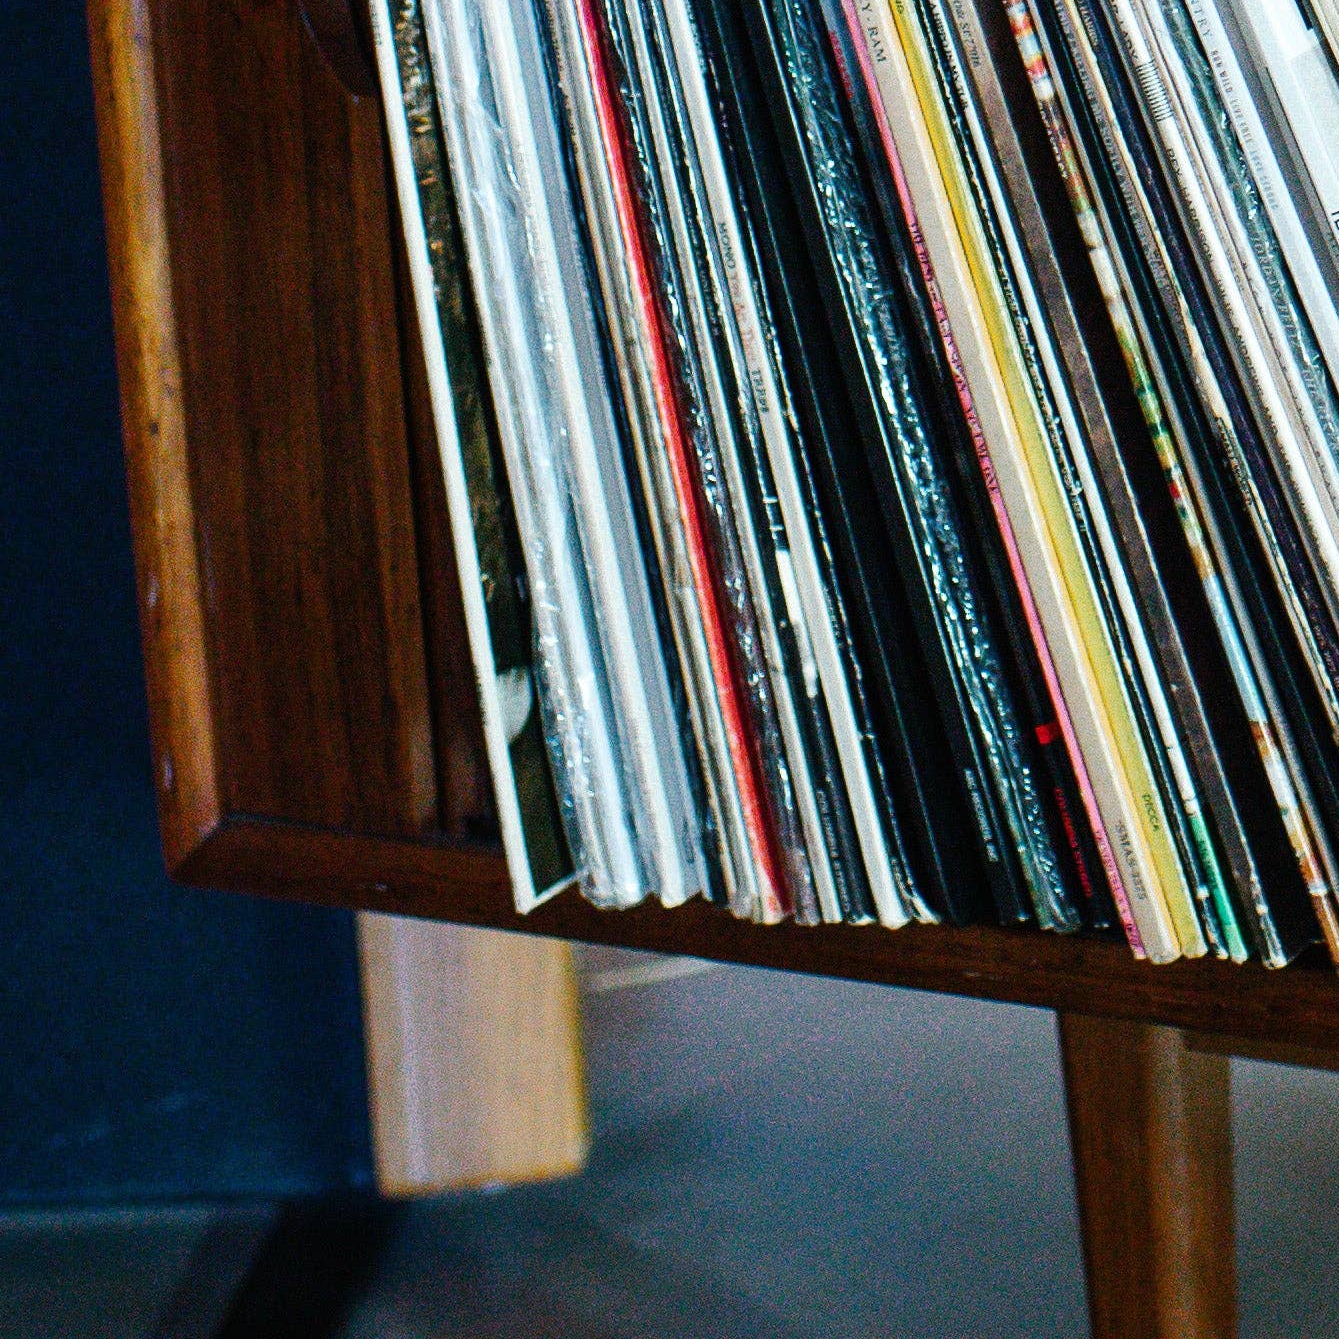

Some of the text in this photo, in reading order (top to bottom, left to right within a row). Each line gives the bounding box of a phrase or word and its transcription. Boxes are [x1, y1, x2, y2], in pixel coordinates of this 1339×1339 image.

[866, 26, 886, 63] RAM
[715, 221, 736, 269] MONO
[1141, 793, 1161, 832] DECCA
